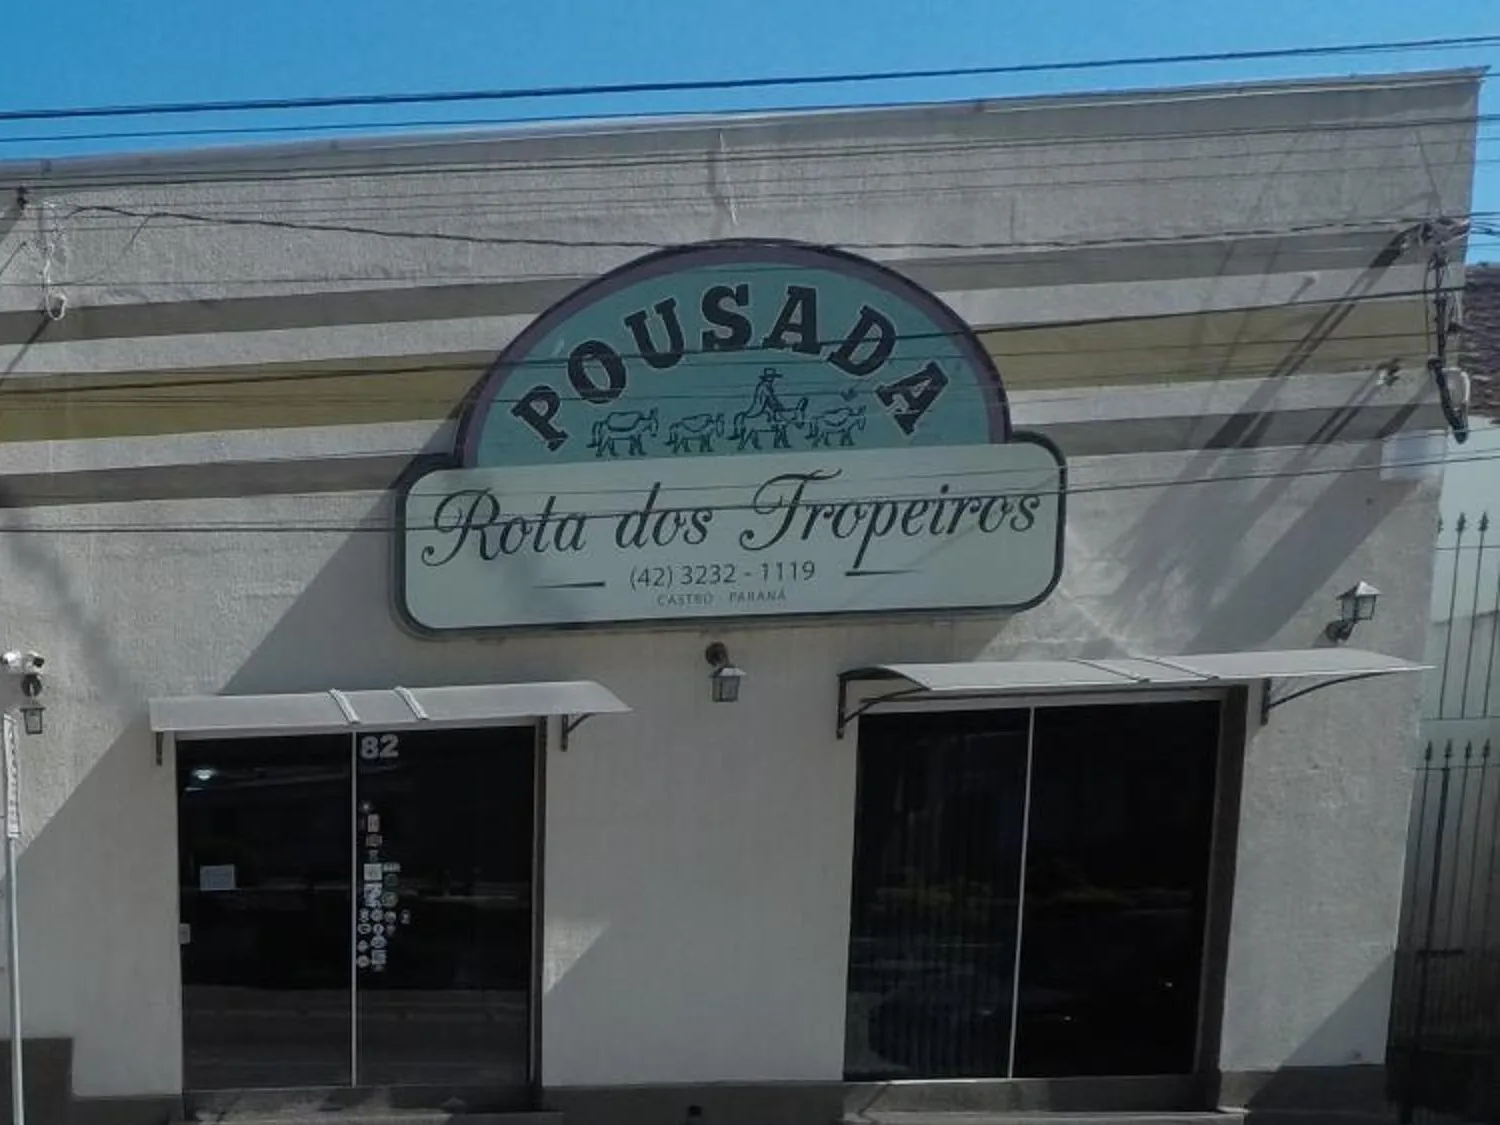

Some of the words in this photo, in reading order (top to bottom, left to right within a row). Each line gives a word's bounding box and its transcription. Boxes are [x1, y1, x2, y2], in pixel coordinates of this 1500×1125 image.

[511, 284, 949, 451] POUSADA
[421, 487, 586, 567] Rota
[614, 481, 713, 549] dos
[738, 467, 1041, 569] Tropeiros
[629, 564, 674, 591] (42)
[680, 563, 737, 586] 3232
[761, 559, 816, 582] 1119
[656, 593, 714, 607] CASTRO
[361, 735, 399, 759] 82
